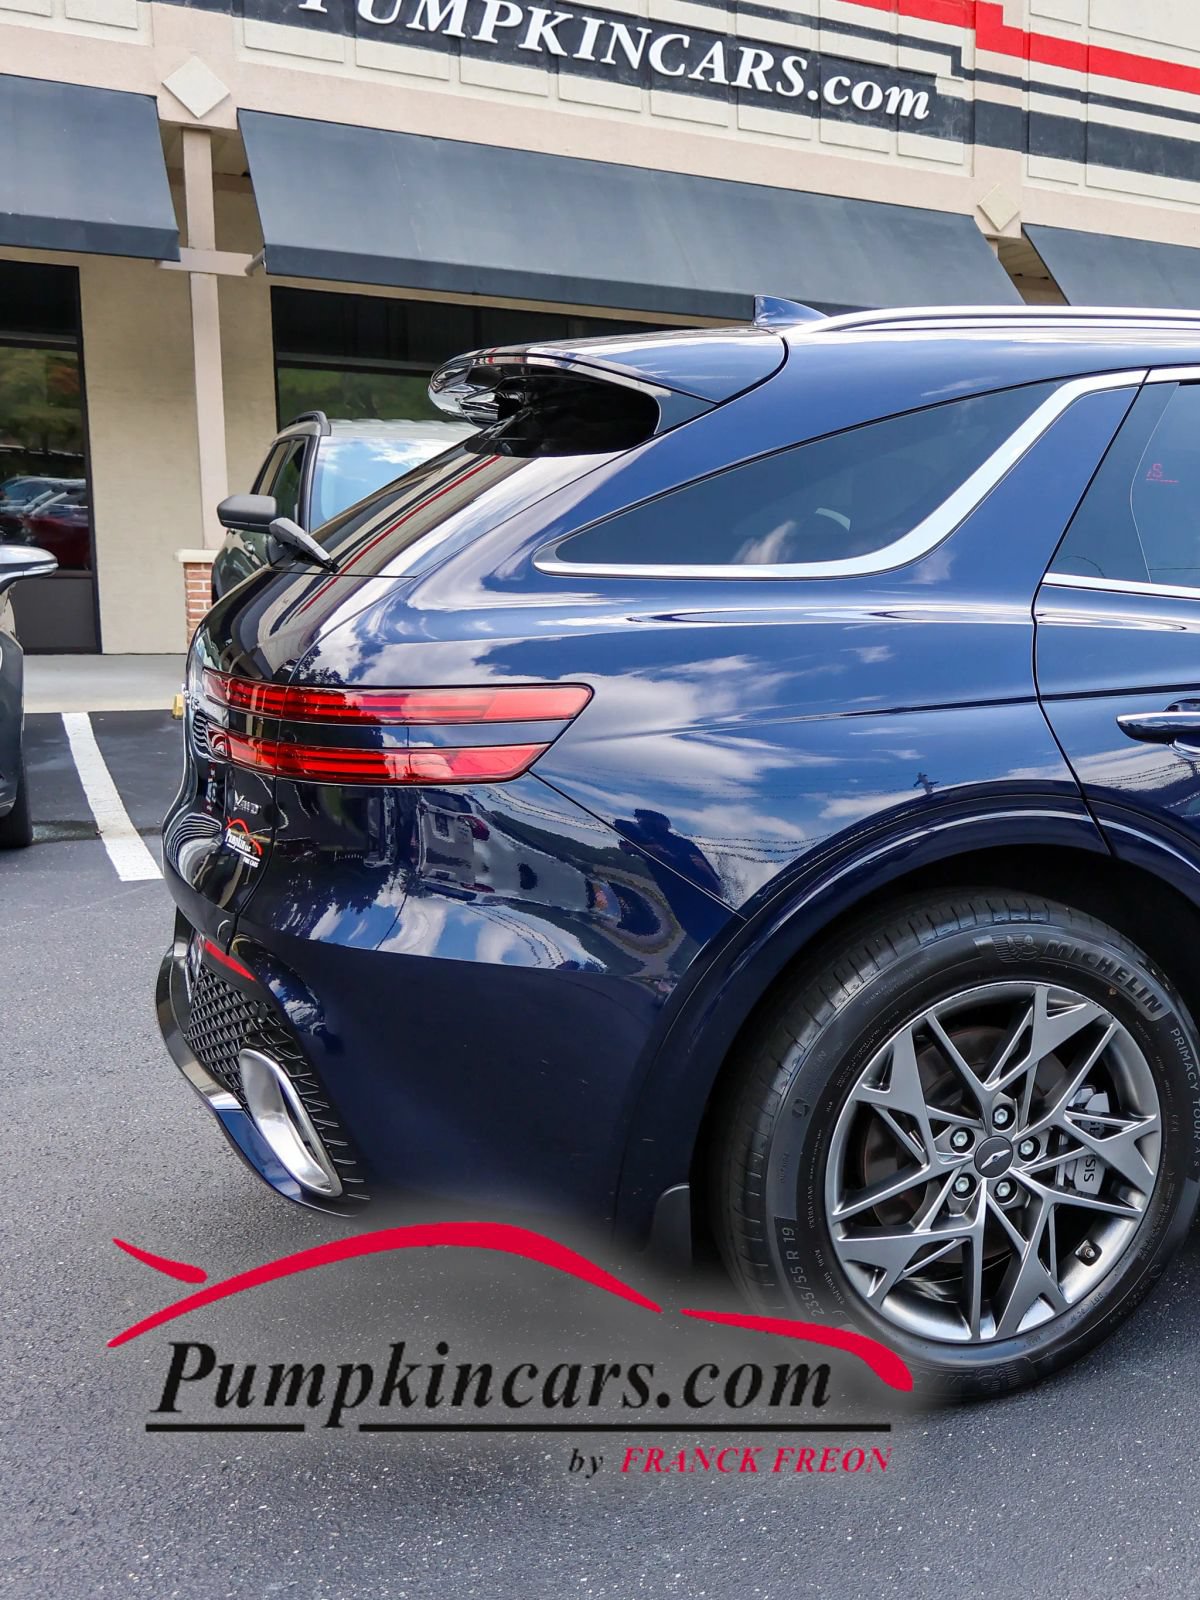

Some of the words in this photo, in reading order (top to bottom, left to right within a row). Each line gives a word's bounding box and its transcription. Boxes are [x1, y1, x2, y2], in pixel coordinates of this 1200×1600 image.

[1047, 939, 1165, 1015] MICHELIN
[1170, 1027, 1199, 1092] PRIMACY
[781, 1226, 796, 1243] 19
[785, 1249, 800, 1260] R
[790, 1265, 825, 1318] 235/55
